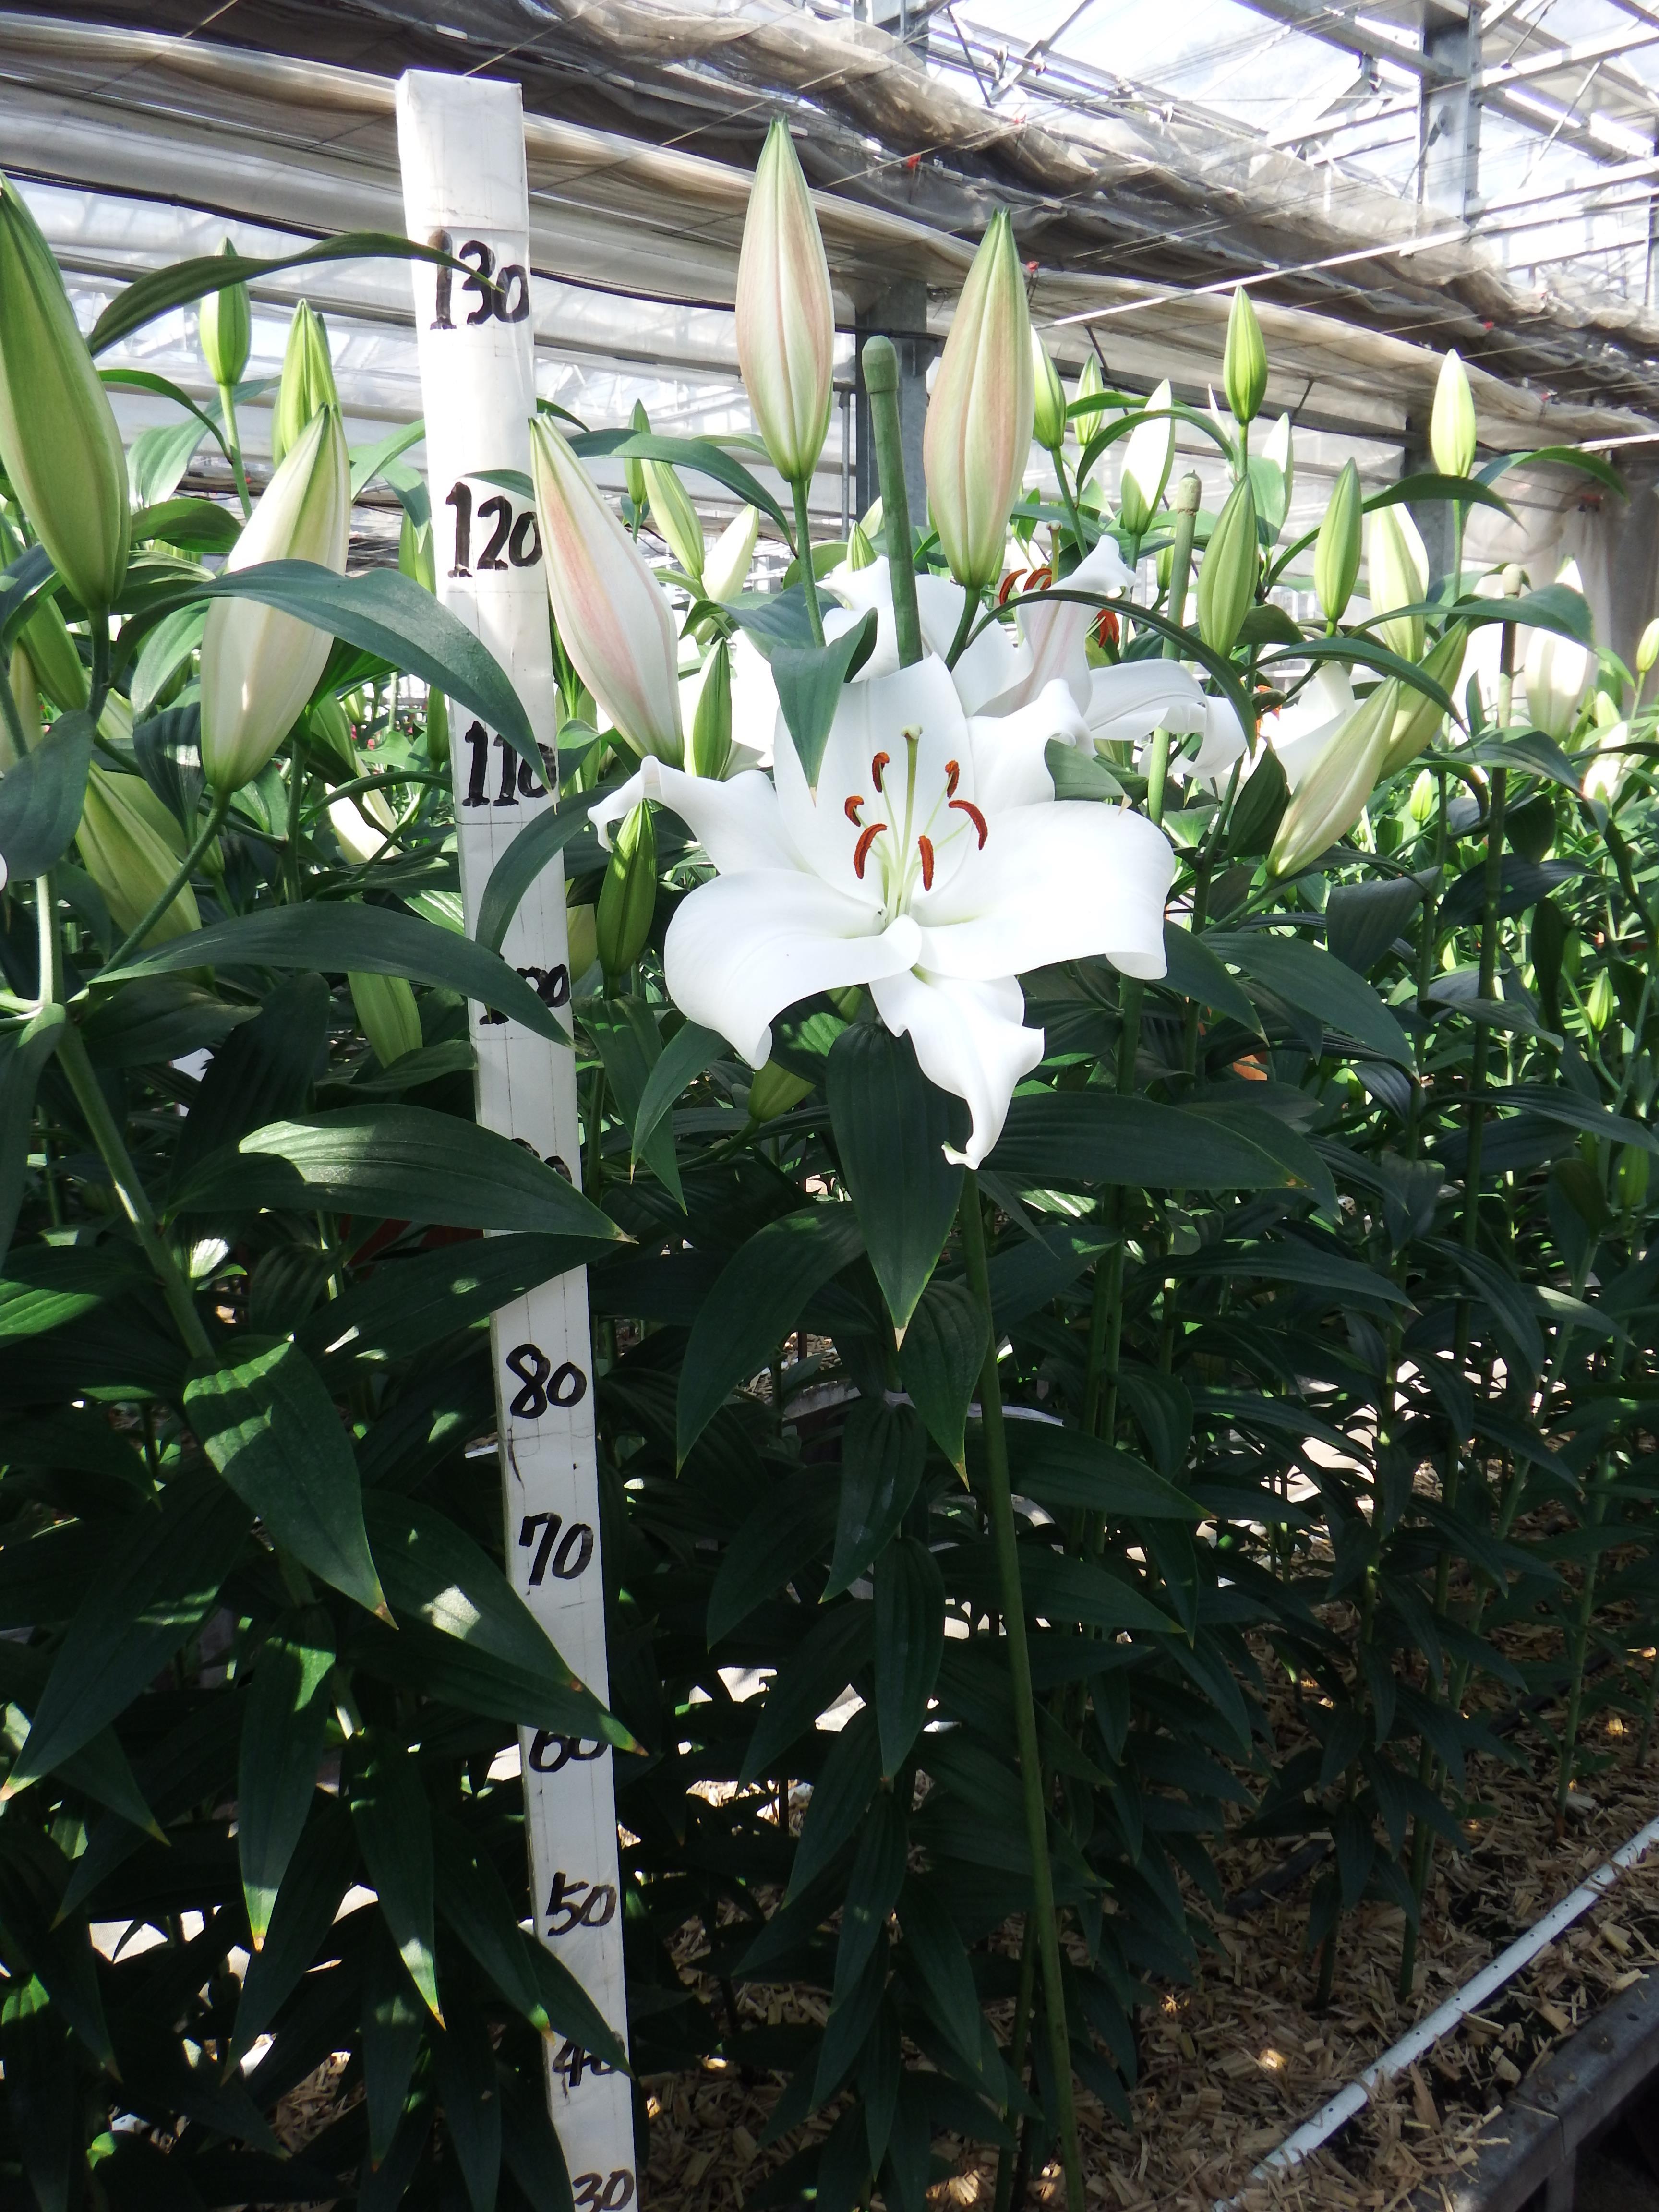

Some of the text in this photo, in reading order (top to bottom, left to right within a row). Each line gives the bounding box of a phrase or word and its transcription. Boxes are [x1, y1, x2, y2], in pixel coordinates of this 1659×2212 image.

[428, 229, 529, 330] 130
[446, 481, 543, 578] 120
[462, 721, 557, 808] 110
[479, 953, 570, 1025] 00
[506, 1344, 587, 1419] 80
[519, 1512, 593, 1585] 70
[546, 1872, 617, 1936] 50
[572, 2169, 634, 2212] 30
